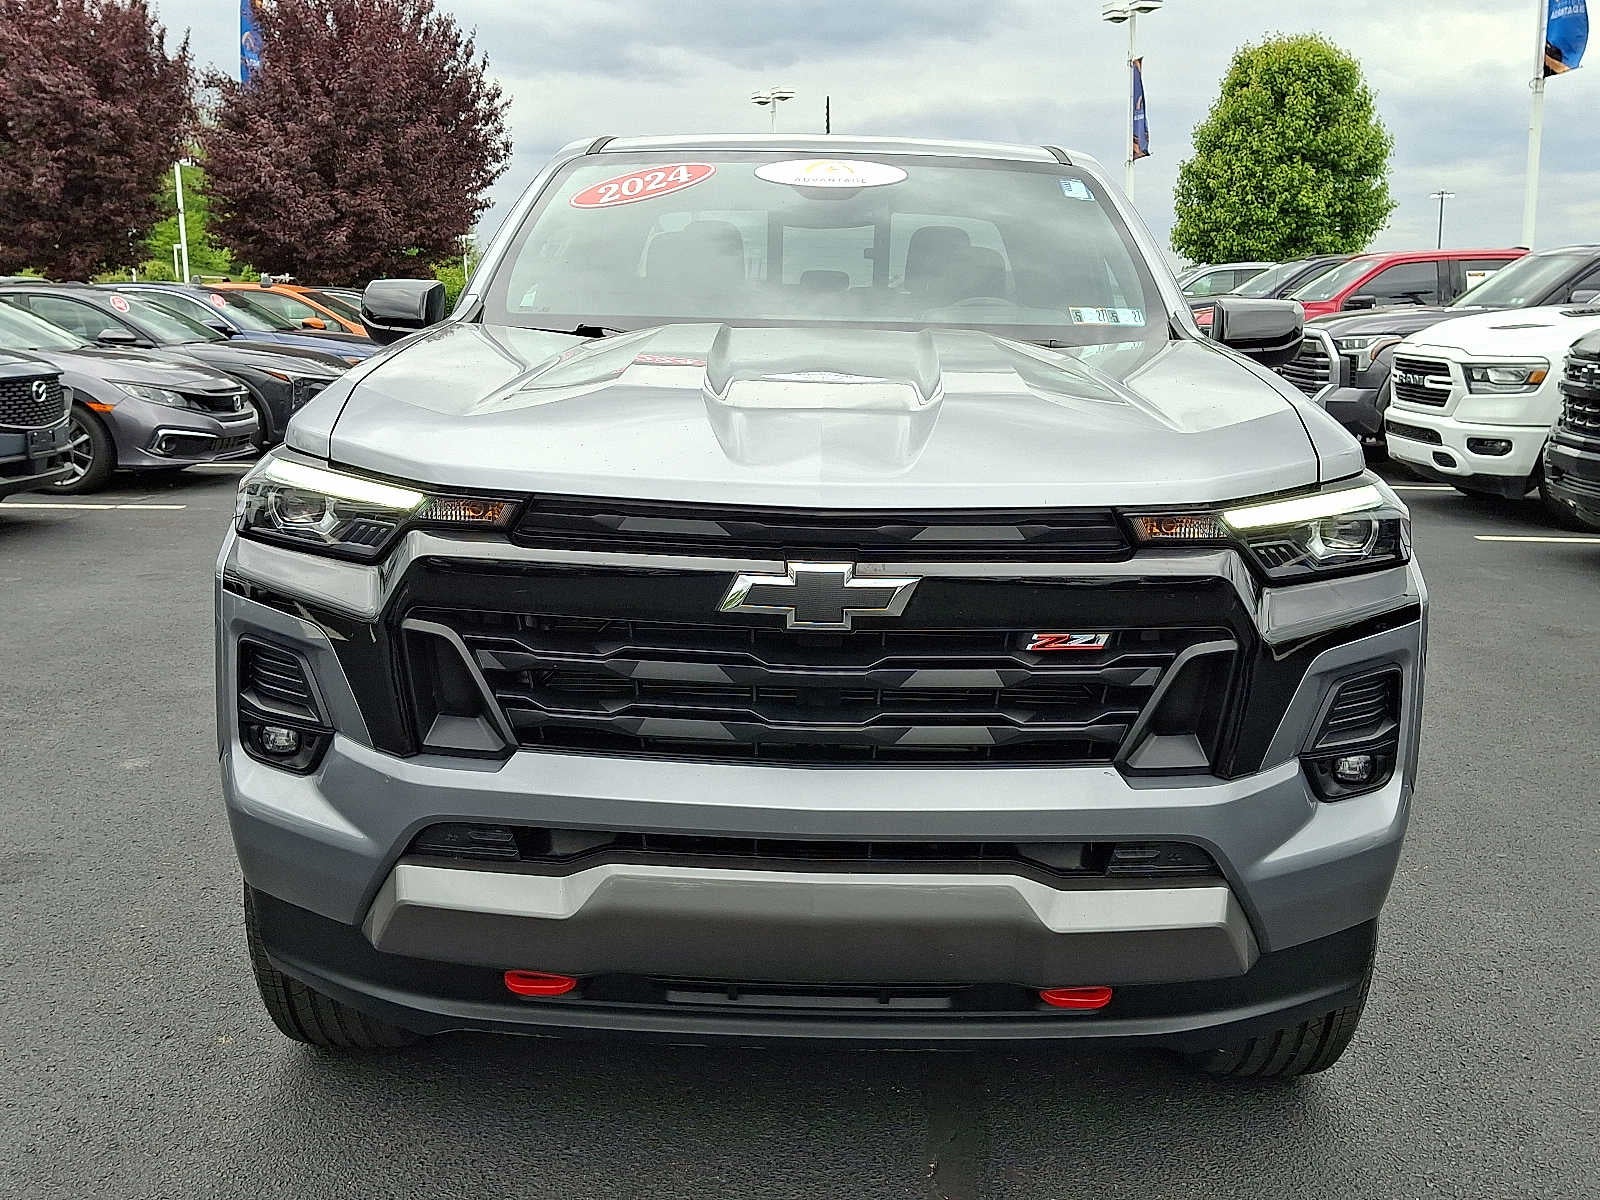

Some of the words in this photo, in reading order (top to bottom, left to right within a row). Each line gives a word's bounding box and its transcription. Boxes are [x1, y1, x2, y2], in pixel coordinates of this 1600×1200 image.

[597, 164, 692, 204] 2024
[1397, 372, 1424, 385] RAM
[1025, 633, 1110, 651] Z71
